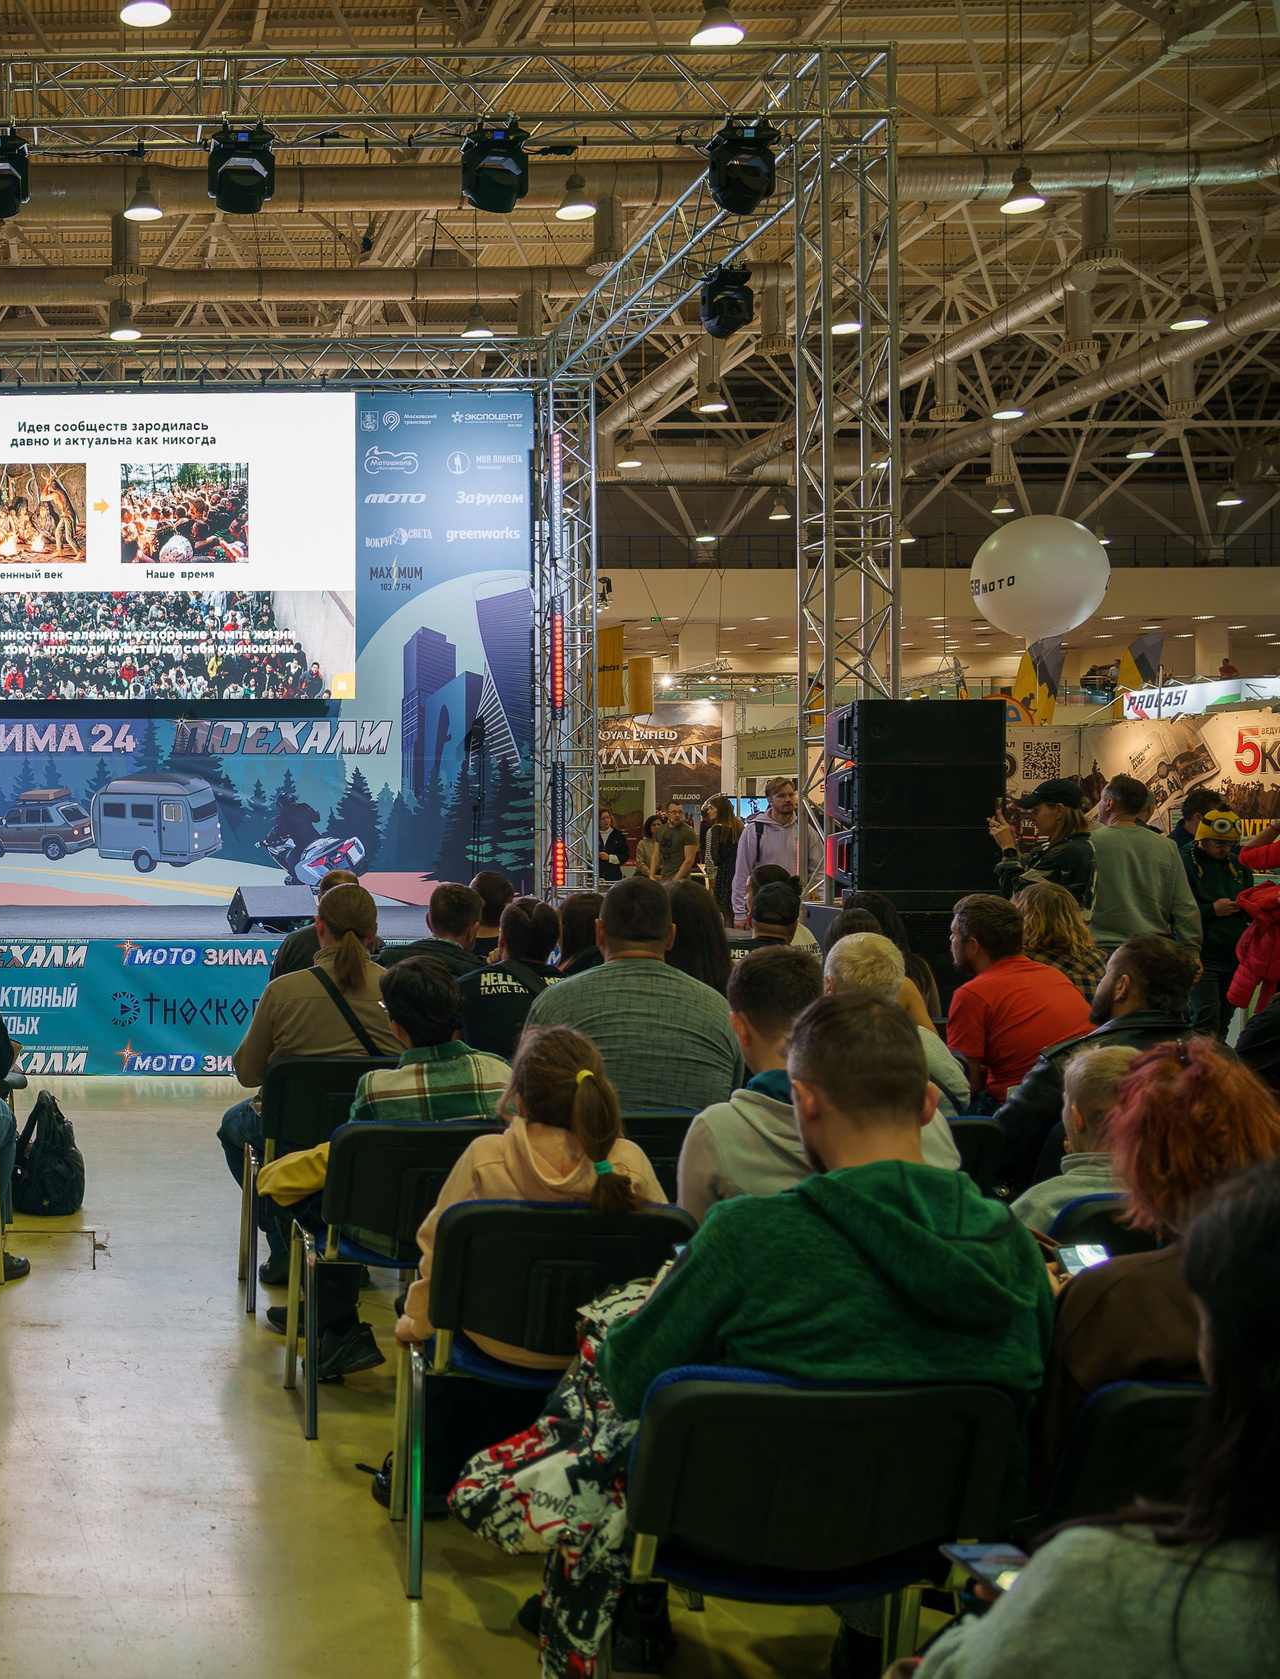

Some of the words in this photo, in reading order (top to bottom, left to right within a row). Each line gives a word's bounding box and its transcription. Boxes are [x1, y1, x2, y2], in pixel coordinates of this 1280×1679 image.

[403, 412, 438, 420] Московский
[464, 413, 523, 421] ЭКСПОЦЕНТР
[17, 421, 50, 434] Идея
[54, 420, 128, 433] сообществ
[131, 421, 209, 432] зародилась
[10, 436, 50, 448] давно
[53, 437, 62, 446] и
[65, 436, 132, 449] актуальна
[136, 436, 159, 446] как
[162, 435, 217, 447] никогда
[475, 454, 491, 464] МОЯ
[492, 454, 523, 464] ПЛАНЕТА
[364, 534, 394, 548] ВОКРУГ
[407, 528, 433, 540] СВЕТА
[446, 526, 520, 543] greenworks
[44, 571, 64, 579] век
[145, 569, 176, 579] Наше
[180, 571, 215, 581] время
[401, 583, 411, 591] FM
[49, 631, 121, 641] населения
[122, 631, 132, 641] и
[136, 631, 208, 642] ускорение
[210, 631, 250, 641] темпа
[253, 631, 296, 641] жизни
[42, 645, 65, 655] что
[68, 645, 106, 657] люди
[183, 643, 217, 655] себя
[217, 644, 299, 656] одинокими.
[90, 723, 137, 753] 24
[171, 719, 394, 755] ПОЕХАЛИ
[632, 729, 678, 741] ENFIELD
[746, 748, 777, 761] THRILLBLAZE
[776, 747, 796, 759] AFRICA
[133, 947, 197, 966] МОТО
[203, 948, 269, 966] ЗИМА
[480, 986, 511, 996] TRAVEL
[10, 1052, 88, 1075] ХАЛИ
[133, 1055, 196, 1072] МОТО
[202, 1054, 236, 1073] ЗИ
